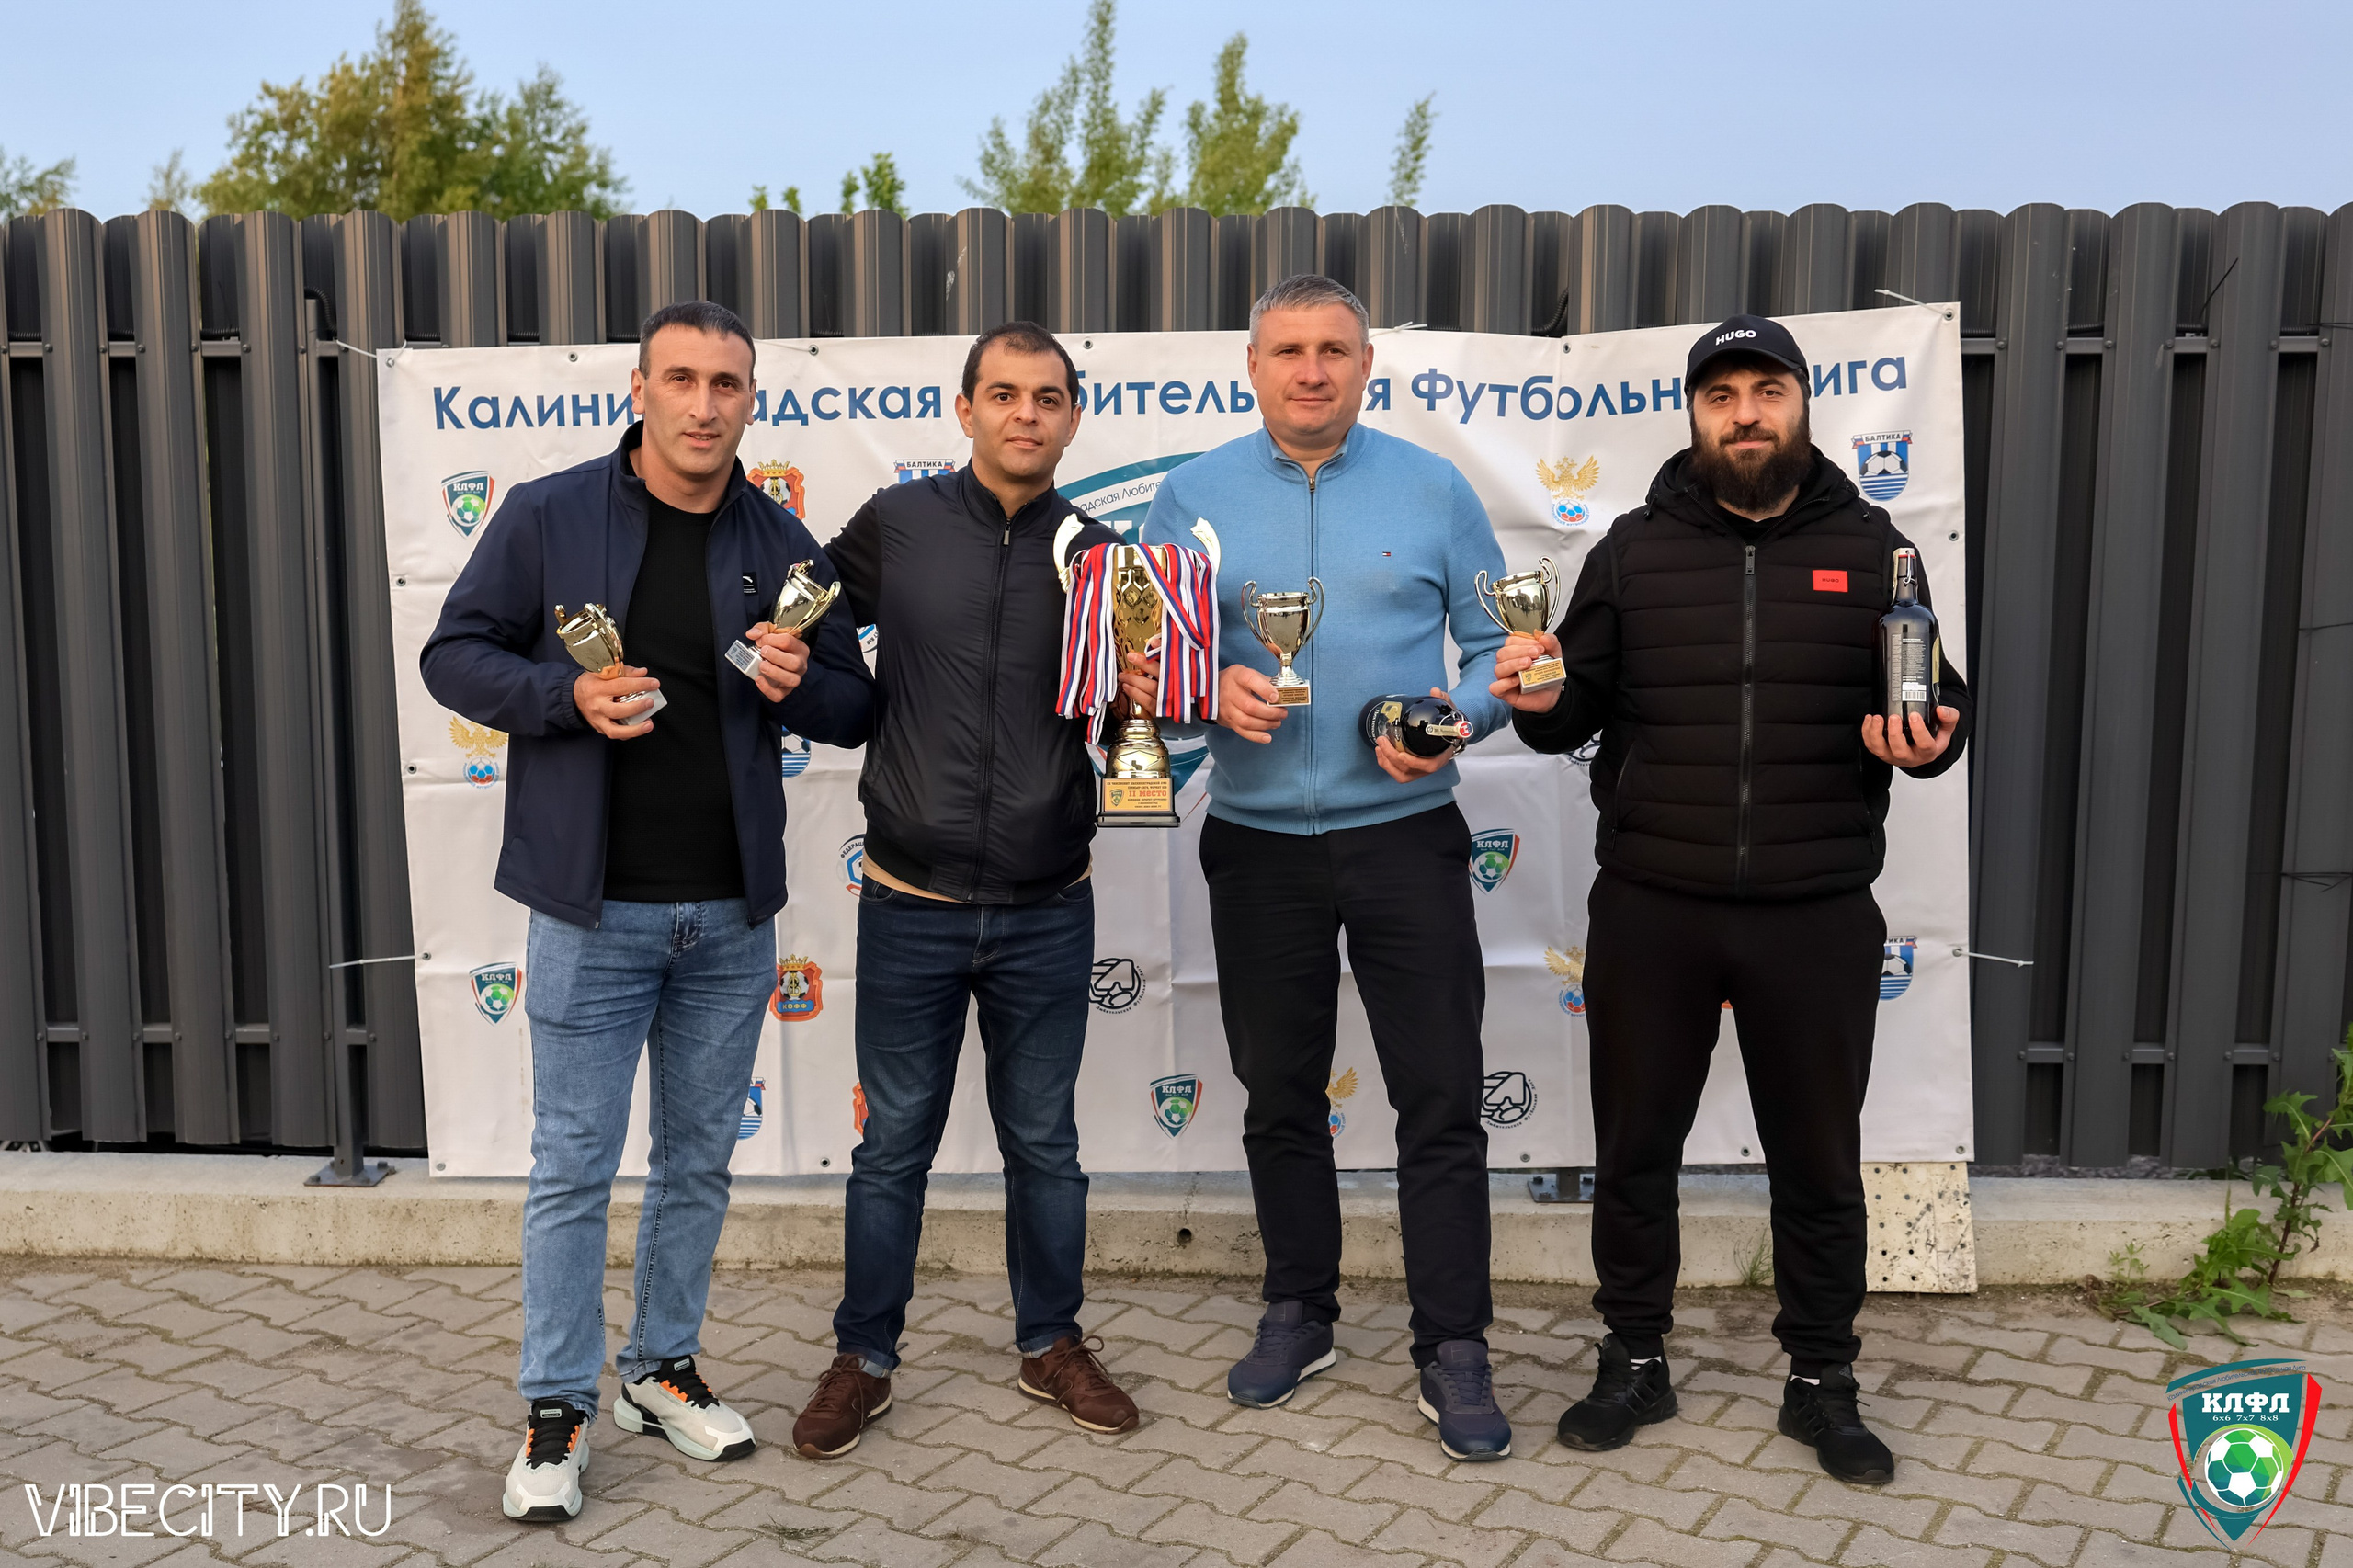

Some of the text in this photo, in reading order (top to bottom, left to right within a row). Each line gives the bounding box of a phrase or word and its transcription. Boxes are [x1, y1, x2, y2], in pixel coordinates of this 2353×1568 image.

[1715, 329, 1756, 346] HUGO
[1411, 368, 1682, 424] Футбольн
[1813, 356, 1907, 398] ига
[1865, 432, 1901, 442] БАЛТИКА
[453, 483, 484, 491] КЛФЛ
[1476, 840, 1508, 848] КЛФЛ
[840, 841, 864, 858] ФЕДЕРАЦ
[1162, 1085, 1192, 1094] КЛФЛ
